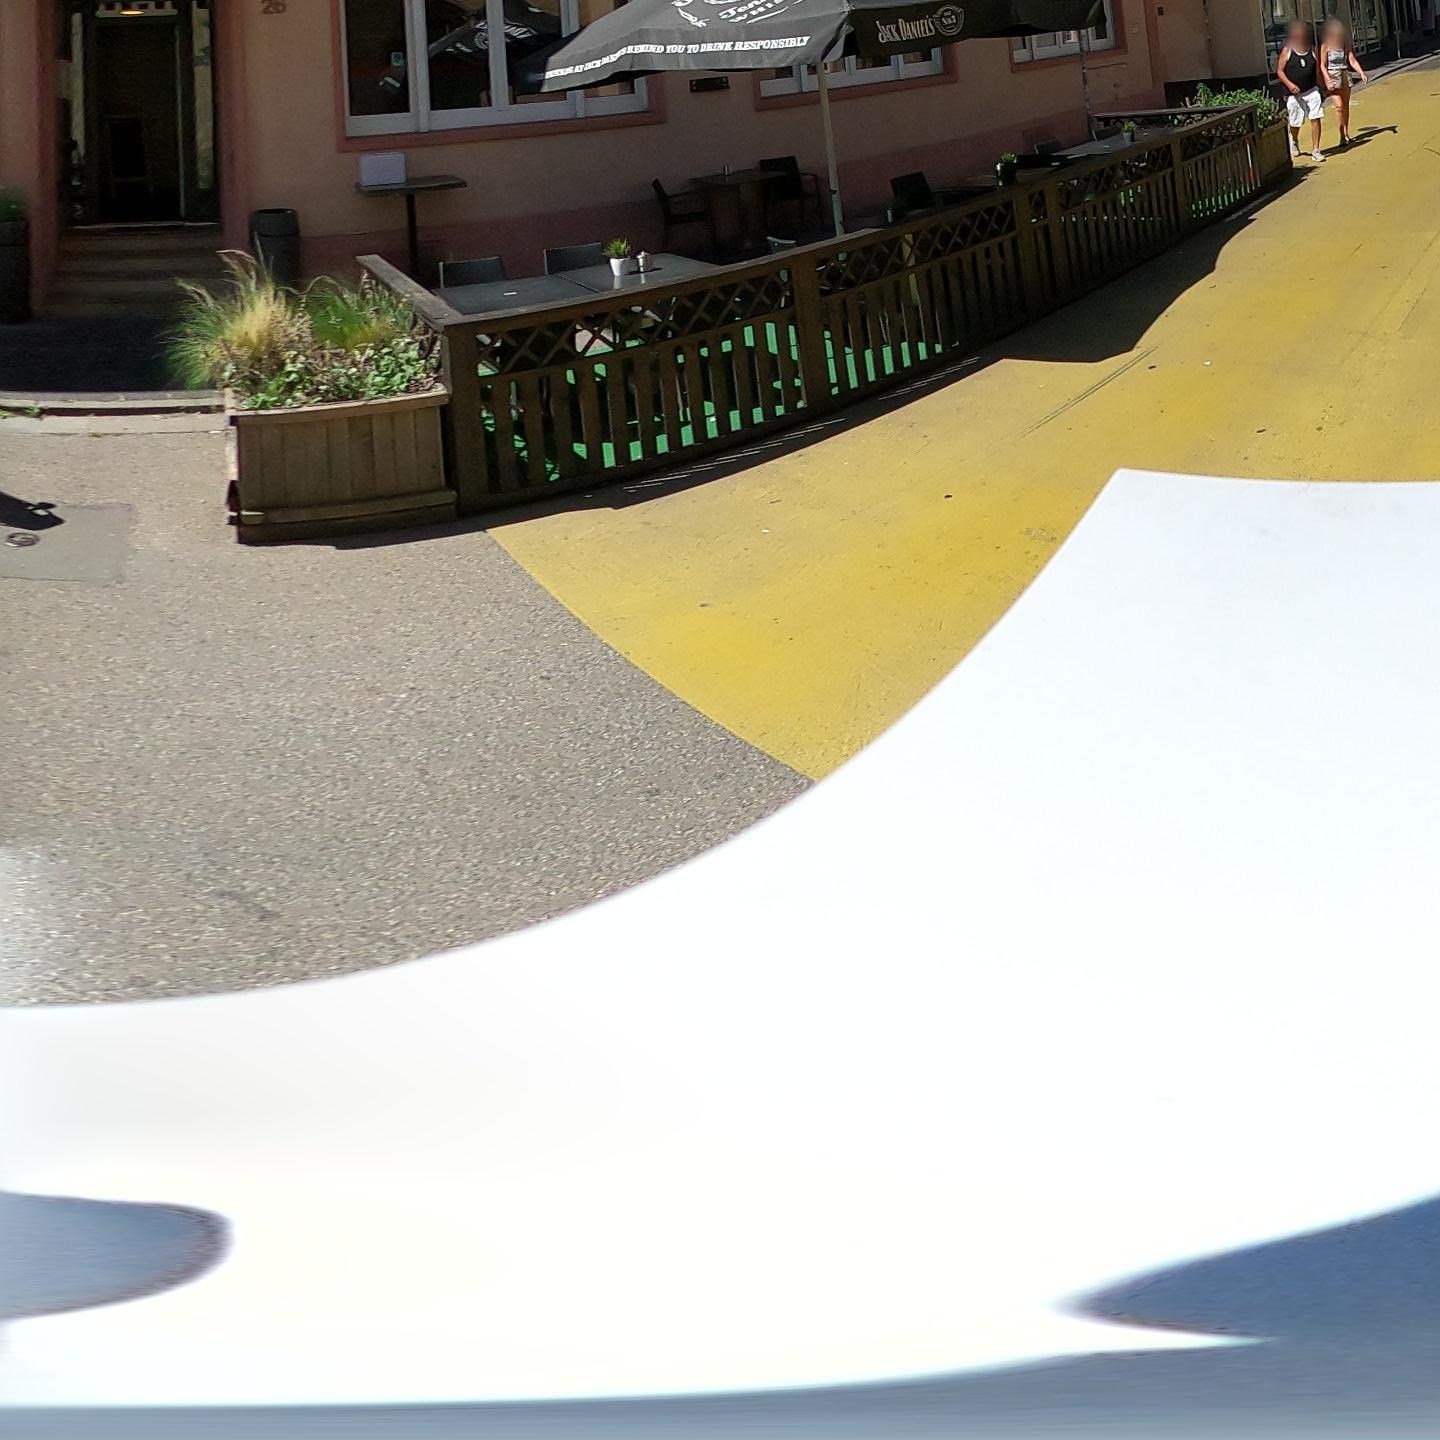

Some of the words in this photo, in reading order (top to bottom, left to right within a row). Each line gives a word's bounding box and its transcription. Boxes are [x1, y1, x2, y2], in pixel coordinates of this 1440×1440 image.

[875, 20, 898, 44] JACK
[666, 44, 687, 54] YOU
[686, 44, 700, 54] TO
[700, 41, 734, 53] DRINK
[733, 36, 811, 51] RESPONSIBLY
